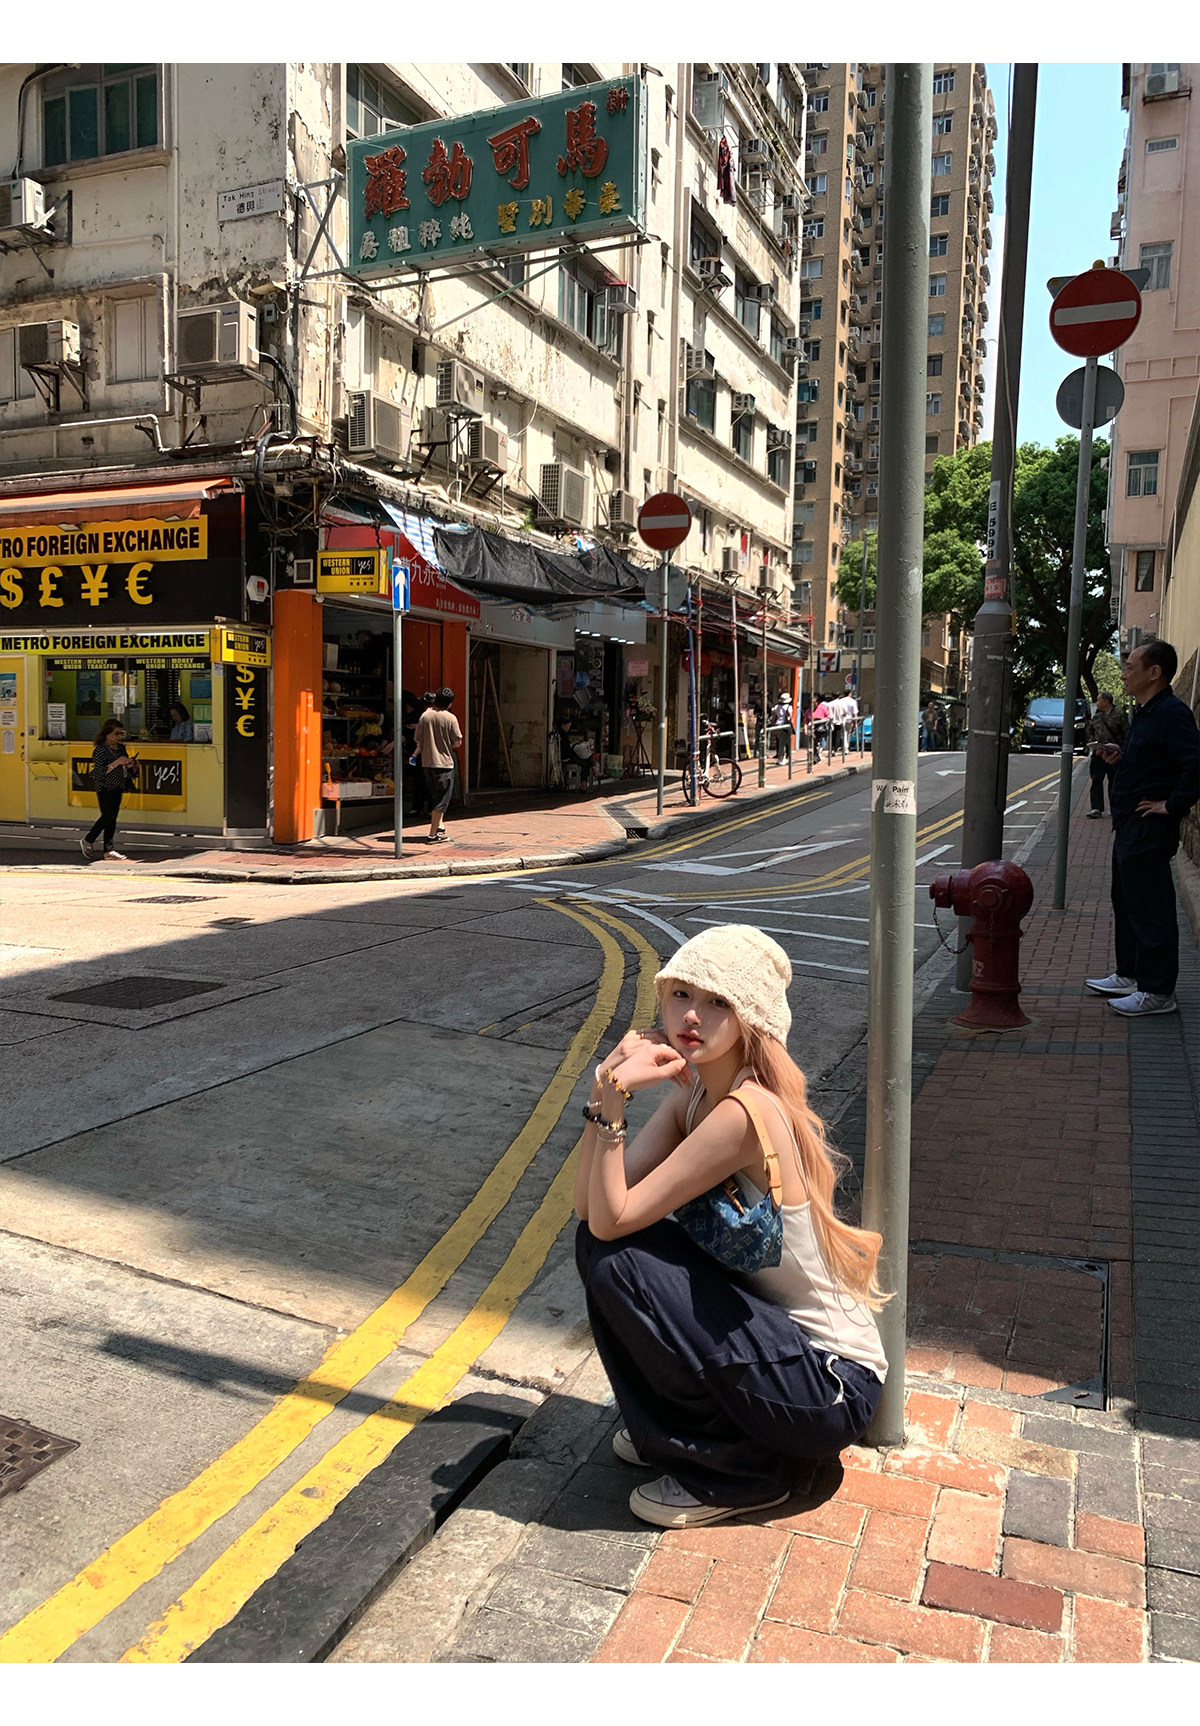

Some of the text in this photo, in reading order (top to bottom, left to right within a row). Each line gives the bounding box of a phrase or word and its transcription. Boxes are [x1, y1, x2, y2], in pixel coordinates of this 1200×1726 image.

[239, 191, 255, 199] Hing
[989, 501, 997, 511] E
[0, 526, 200, 558] RO FOREIGN EXCHANGE
[322, 558, 350, 567] WESTERN
[331, 567, 350, 575] UNION
[0, 562, 153, 609] $ £ ¥ €
[1, 634, 205, 650] METRO FOREIGN EXCHANGE
[822, 652, 836, 672] 7
[235, 687, 255, 710] ¥
[235, 714, 255, 737] €
[153, 762, 180, 790] yes!
[892, 785, 910, 794] Pain
